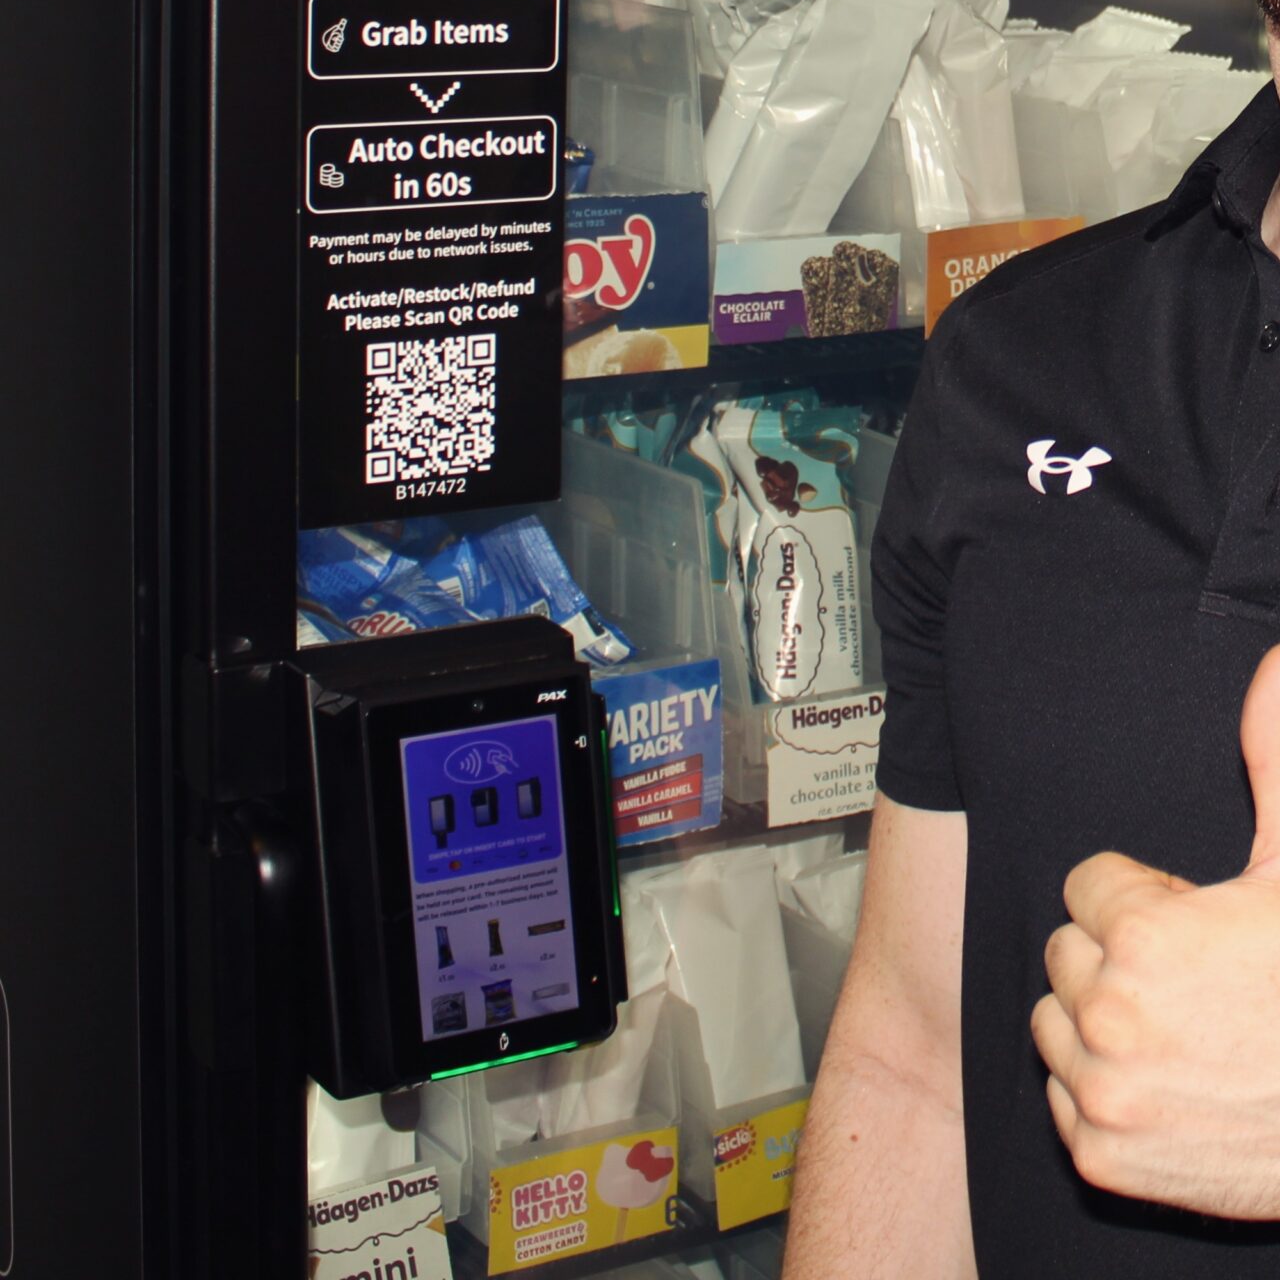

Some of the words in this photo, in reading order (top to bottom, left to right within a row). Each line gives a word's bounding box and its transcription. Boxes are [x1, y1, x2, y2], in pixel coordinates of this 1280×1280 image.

[362, 19, 427, 47] Grab
[434, 20, 509, 45] Items
[348, 138, 414, 164] Auto
[420, 131, 546, 160] Checkout
[394, 173, 419, 200] in
[426, 172, 472, 198] 60s
[309, 233, 369, 250] Payment
[372, 231, 401, 246] may
[405, 229, 422, 242] be
[425, 225, 478, 242] delayed
[481, 224, 498, 239] by
[500, 221, 551, 236] minutes
[329, 252, 344, 265] or
[347, 250, 386, 264] hours
[388, 248, 415, 261] due
[417, 246, 431, 260] to
[434, 242, 487, 258] network
[490, 239, 533, 254] issues.
[944, 248, 1031, 279] ORAN
[327, 278, 535, 311] Activate/Restock/Refund
[719, 300, 786, 314] CHOCOLATE
[345, 313, 401, 331] Please
[404, 309, 445, 327] Scan
[448, 306, 473, 325] QR
[476, 303, 519, 320] Code
[733, 311, 772, 324] ECLAIR
[396, 478, 467, 500] B147472
[832, 570, 845, 601] milk
[835, 604, 848, 652] vanilla
[537, 689, 567, 704] PAX
[792, 696, 884, 729] Häagen-D
[630, 731, 684, 764] PACK
[623, 770, 659, 791] VANILLA
[659, 761, 687, 780] FUDGE
[813, 762, 861, 782] vanilla
[617, 795, 653, 812] VANILLA
[653, 783, 693, 802] CARAMEL
[790, 780, 862, 805] chocolate
[637, 809, 673, 827] VANILLA
[512, 1170, 587, 1210] HELLO
[513, 1190, 586, 1230] KITTY
[517, 1244, 552, 1261] COTTON
[555, 1233, 585, 1252] CANDY
